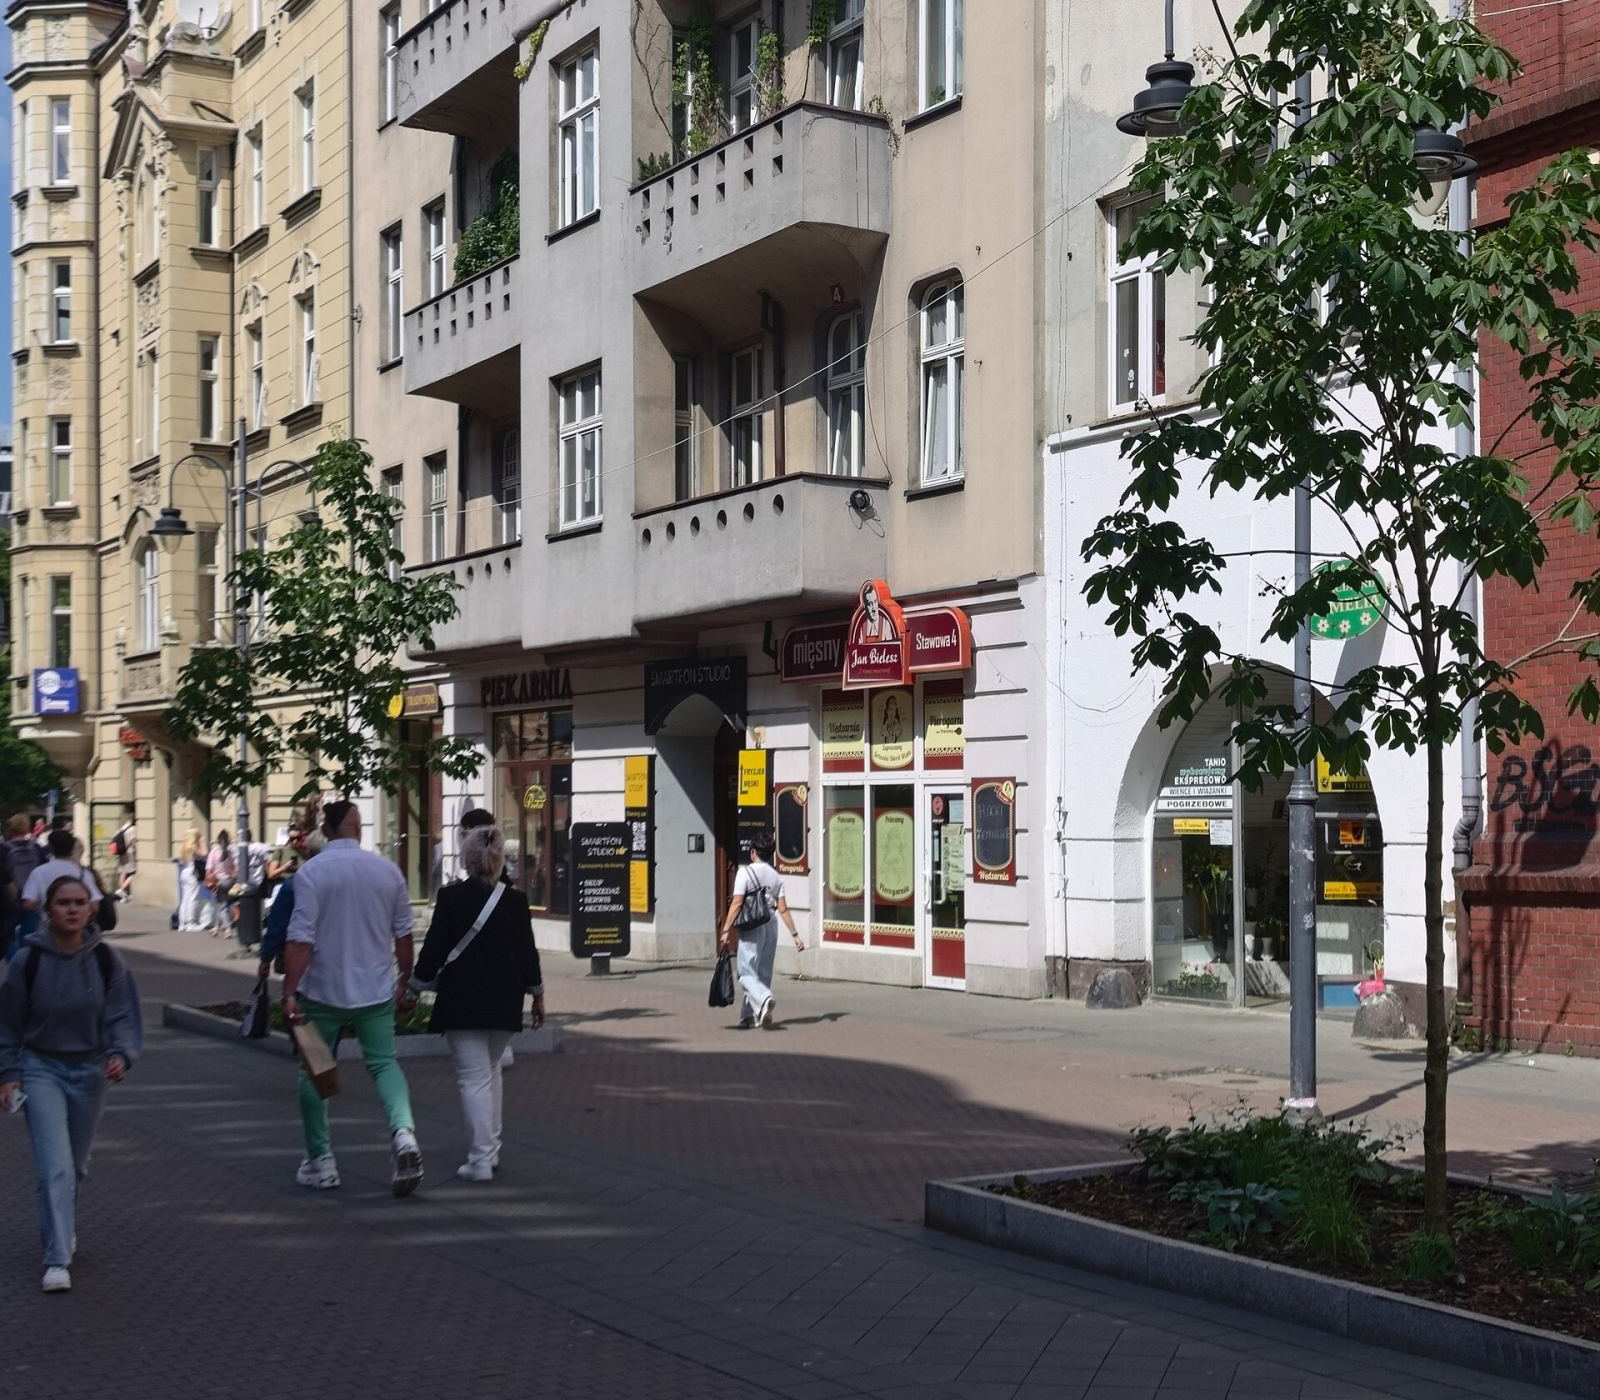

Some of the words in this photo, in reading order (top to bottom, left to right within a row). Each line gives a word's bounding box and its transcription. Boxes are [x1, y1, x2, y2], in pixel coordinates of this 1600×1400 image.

[833, 287, 841, 302] 4
[1328, 595, 1381, 614] MELIA
[916, 632, 950, 650] Stawowa
[951, 628, 957, 647] 4
[793, 634, 841, 670] mięsny
[851, 649, 867, 668] Jan
[869, 648, 898, 665] Bielesz
[650, 668, 696, 686] SMARTFON
[698, 665, 731, 683] STUDIO
[480, 668, 572, 708] PIEKARNIA
[1204, 757, 1227, 767] TANIO
[744, 768, 765, 776] FRYZJER
[1174, 776, 1227, 785] EKSPRESOWO
[1167, 800, 1228, 808] POGRZEBOWE
[580, 837, 622, 846] SMARTFON
[587, 847, 615, 857] STUDIO
[978, 871, 1010, 881] Wędzarnia
[584, 879, 604, 887] SKUP
[584, 896, 612, 904] SERWIS
[584, 904, 625, 913] AKCESORIA
